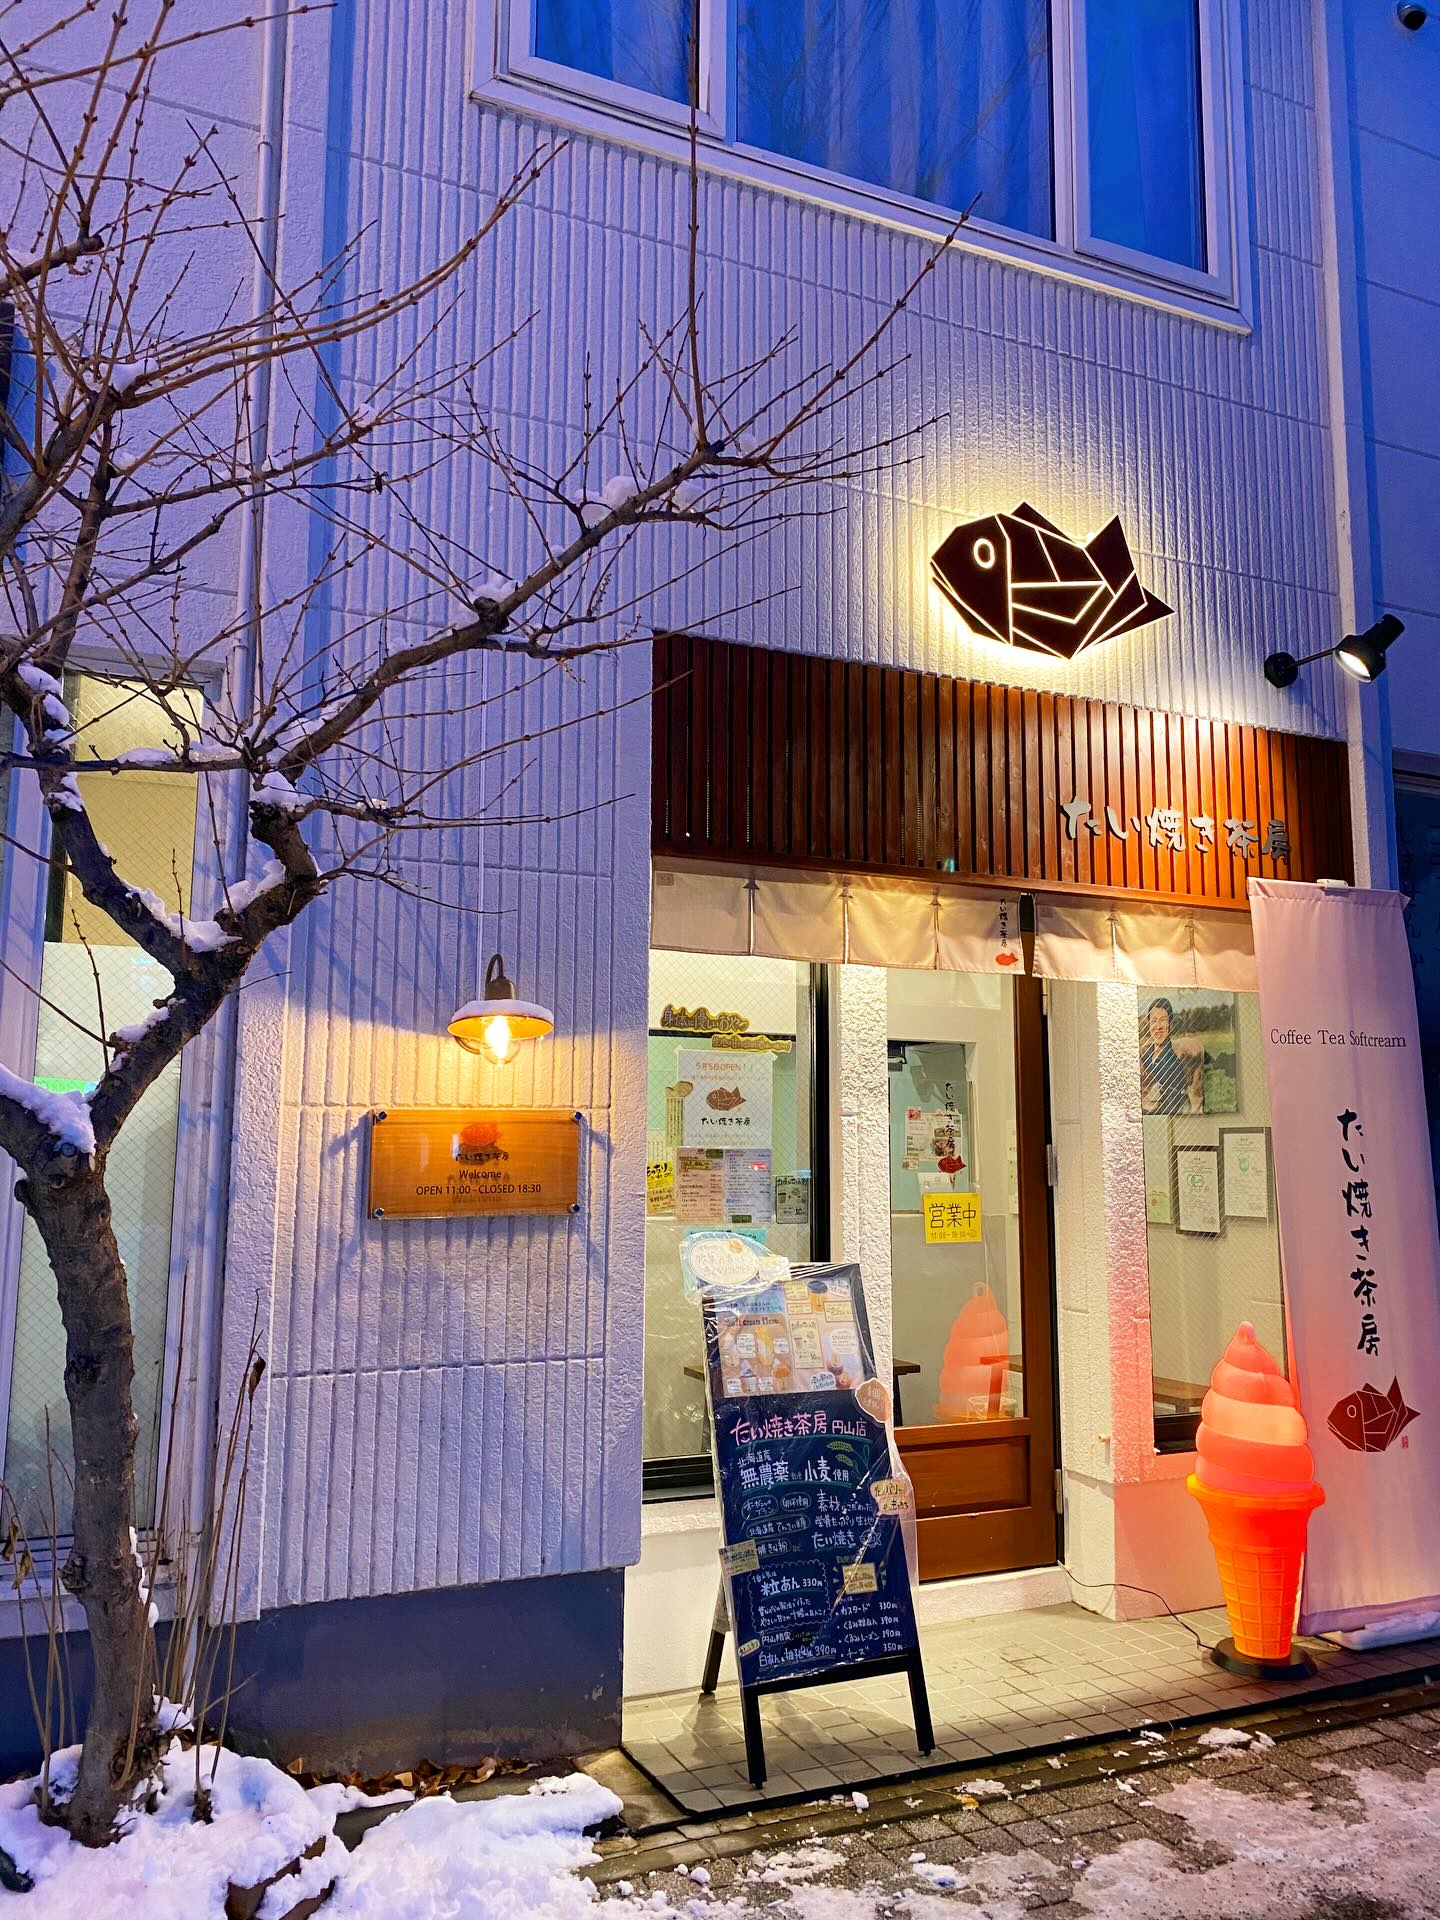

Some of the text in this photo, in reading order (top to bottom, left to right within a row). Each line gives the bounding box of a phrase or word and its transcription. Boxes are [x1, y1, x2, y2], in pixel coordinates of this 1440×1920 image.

[1061, 797, 1291, 864] たい焼き茶房
[1000, 898, 1008, 948] たい焼き茶房
[1271, 1029, 1407, 1048] Coffee Tea Softcream
[701, 1117, 751, 1126] たい焼き茶房
[945, 1082, 955, 1153] たい焼き茶房
[459, 1170, 502, 1179] Welcome
[416, 1186, 442, 1195] OPEN
[446, 1186, 471, 1194] 11:00
[478, 1185, 514, 1194] CLOSED
[518, 1184, 541, 1193] 18:30
[929, 1202, 976, 1228] 営業中
[1337, 1108, 1380, 1356] たい焼き茶房
[730, 1410, 867, 1446] たい焼き茶房 円山店
[738, 1449, 772, 1467] 北海道産
[741, 1460, 789, 1490] 無農薬
[805, 1456, 831, 1482] 小麦
[833, 1469, 849, 1481] 使用
[812, 1530, 857, 1549] たい焼き
[761, 1576, 823, 1596] 粒あん 330円
[841, 1602, 871, 1615] カスタード
[880, 1616, 899, 1625] 390円
[882, 1630, 901, 1639] 390円
[815, 1643, 837, 1656] 390円
[847, 1646, 870, 1658] チーズ
